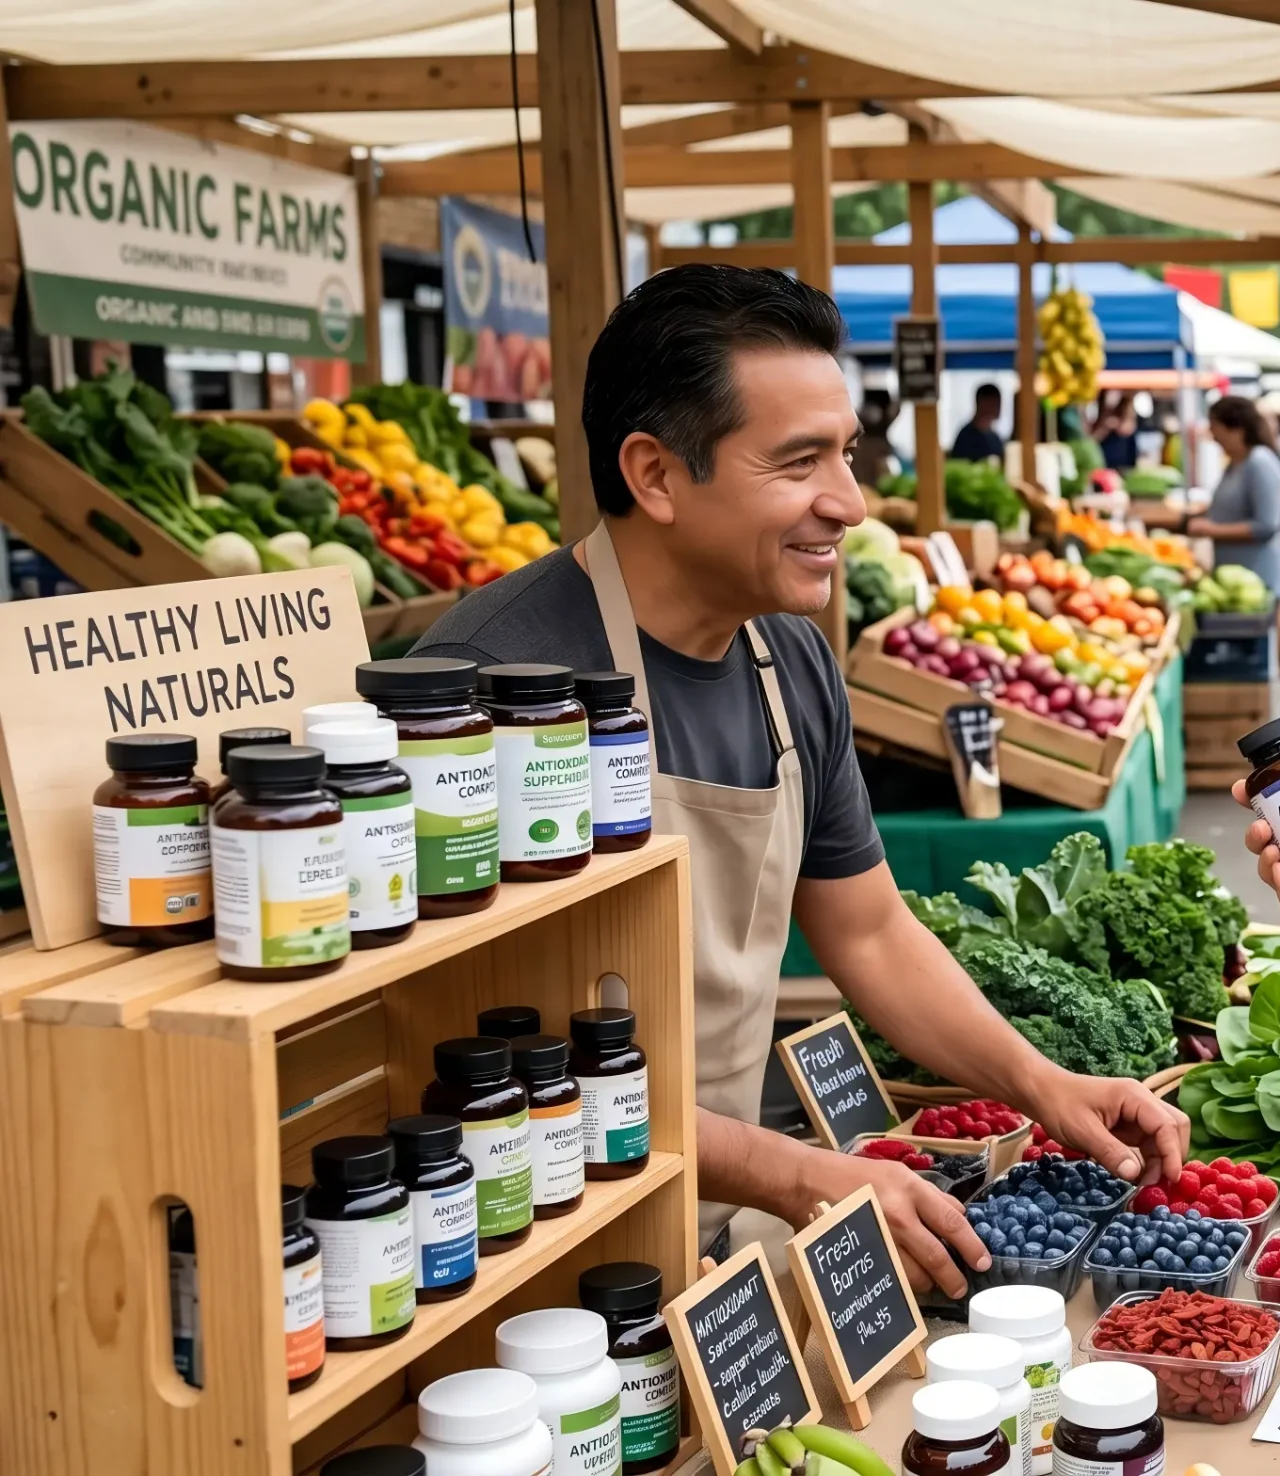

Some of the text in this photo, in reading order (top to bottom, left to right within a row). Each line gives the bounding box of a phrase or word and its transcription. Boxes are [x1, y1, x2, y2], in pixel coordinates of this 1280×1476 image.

[11, 131, 348, 264] ORGANIC FARMS
[120, 243, 216, 278] COMMUNITY
[24, 588, 331, 675] HEALTHY LIVING
[103, 655, 296, 733] NATURALS
[814, 1224, 860, 1274] Fresh
